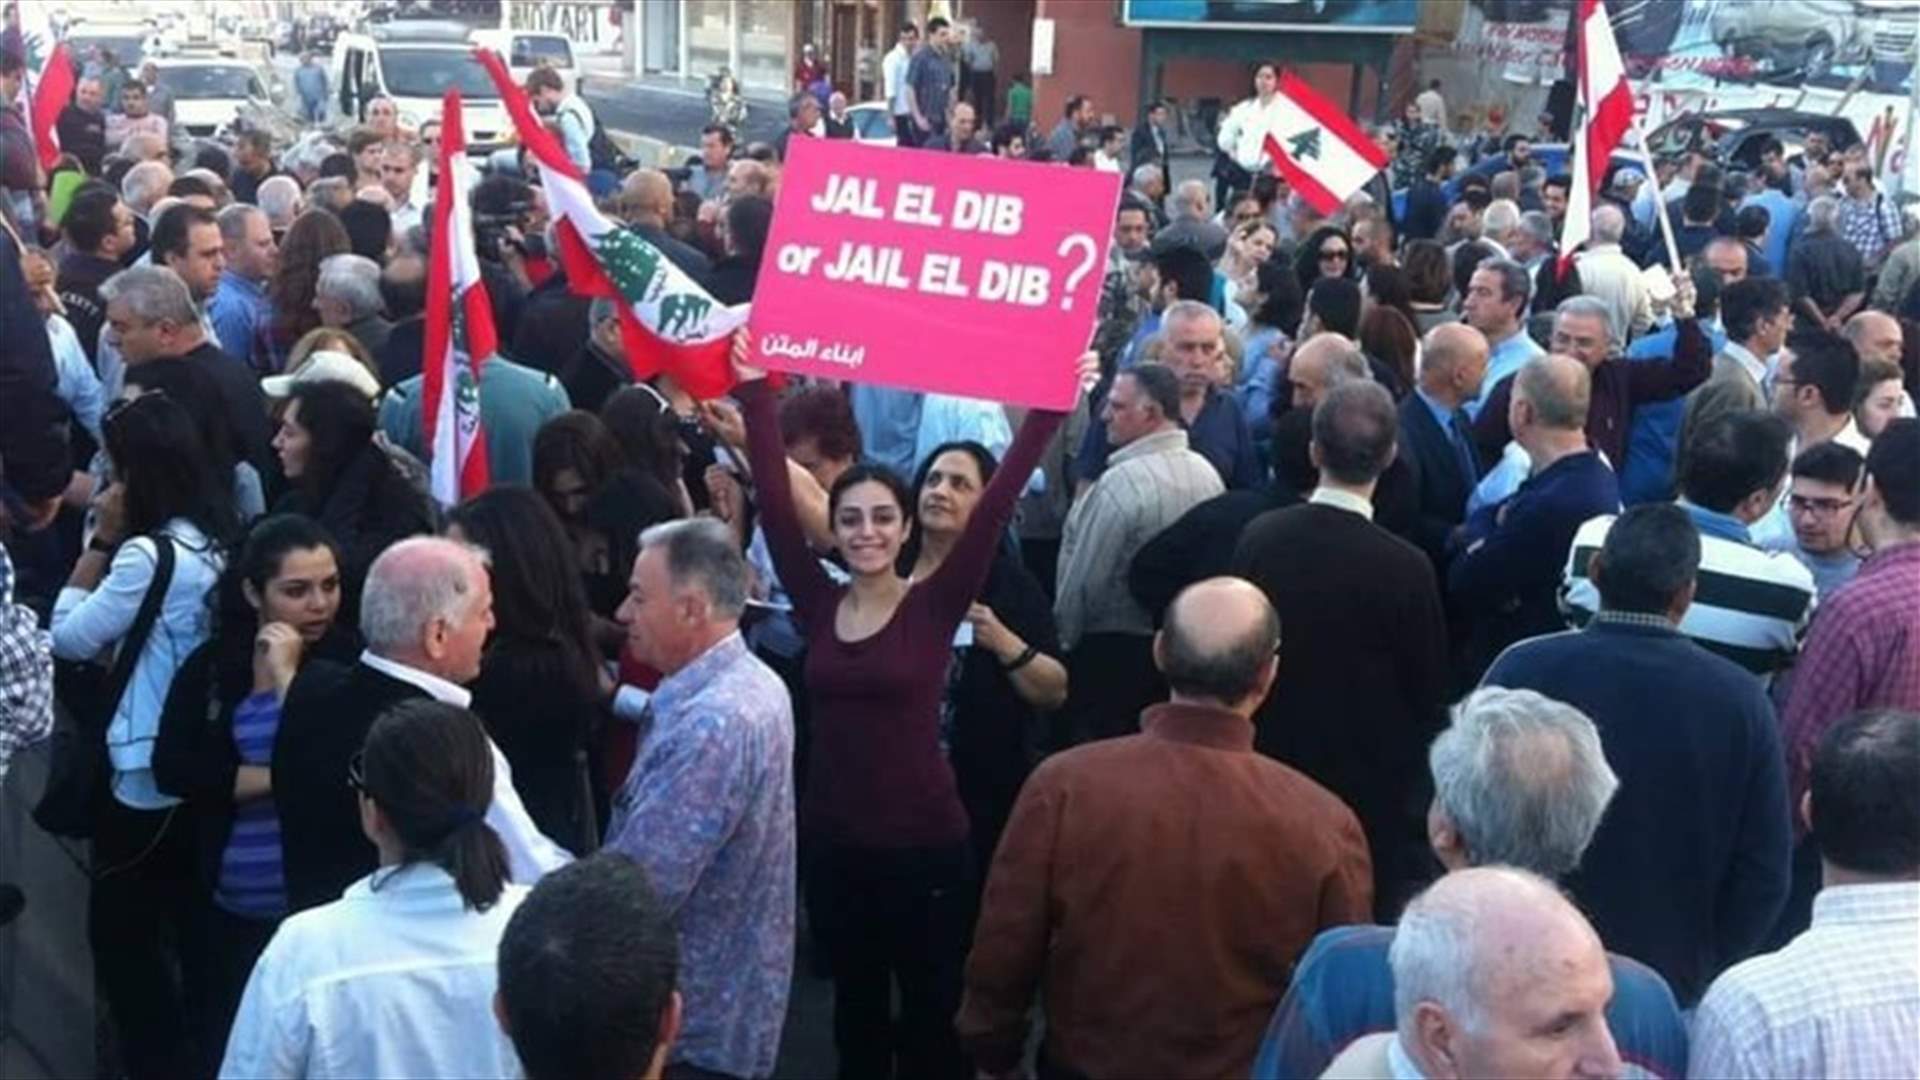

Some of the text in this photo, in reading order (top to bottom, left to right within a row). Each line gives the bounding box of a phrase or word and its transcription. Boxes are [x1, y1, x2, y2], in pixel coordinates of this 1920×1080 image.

[810, 173, 1025, 236] JAL EL DIB
[777, 243, 821, 275] or
[823, 241, 911, 289] JAIL
[918, 253, 970, 297] EL
[977, 260, 1051, 306] DIB
